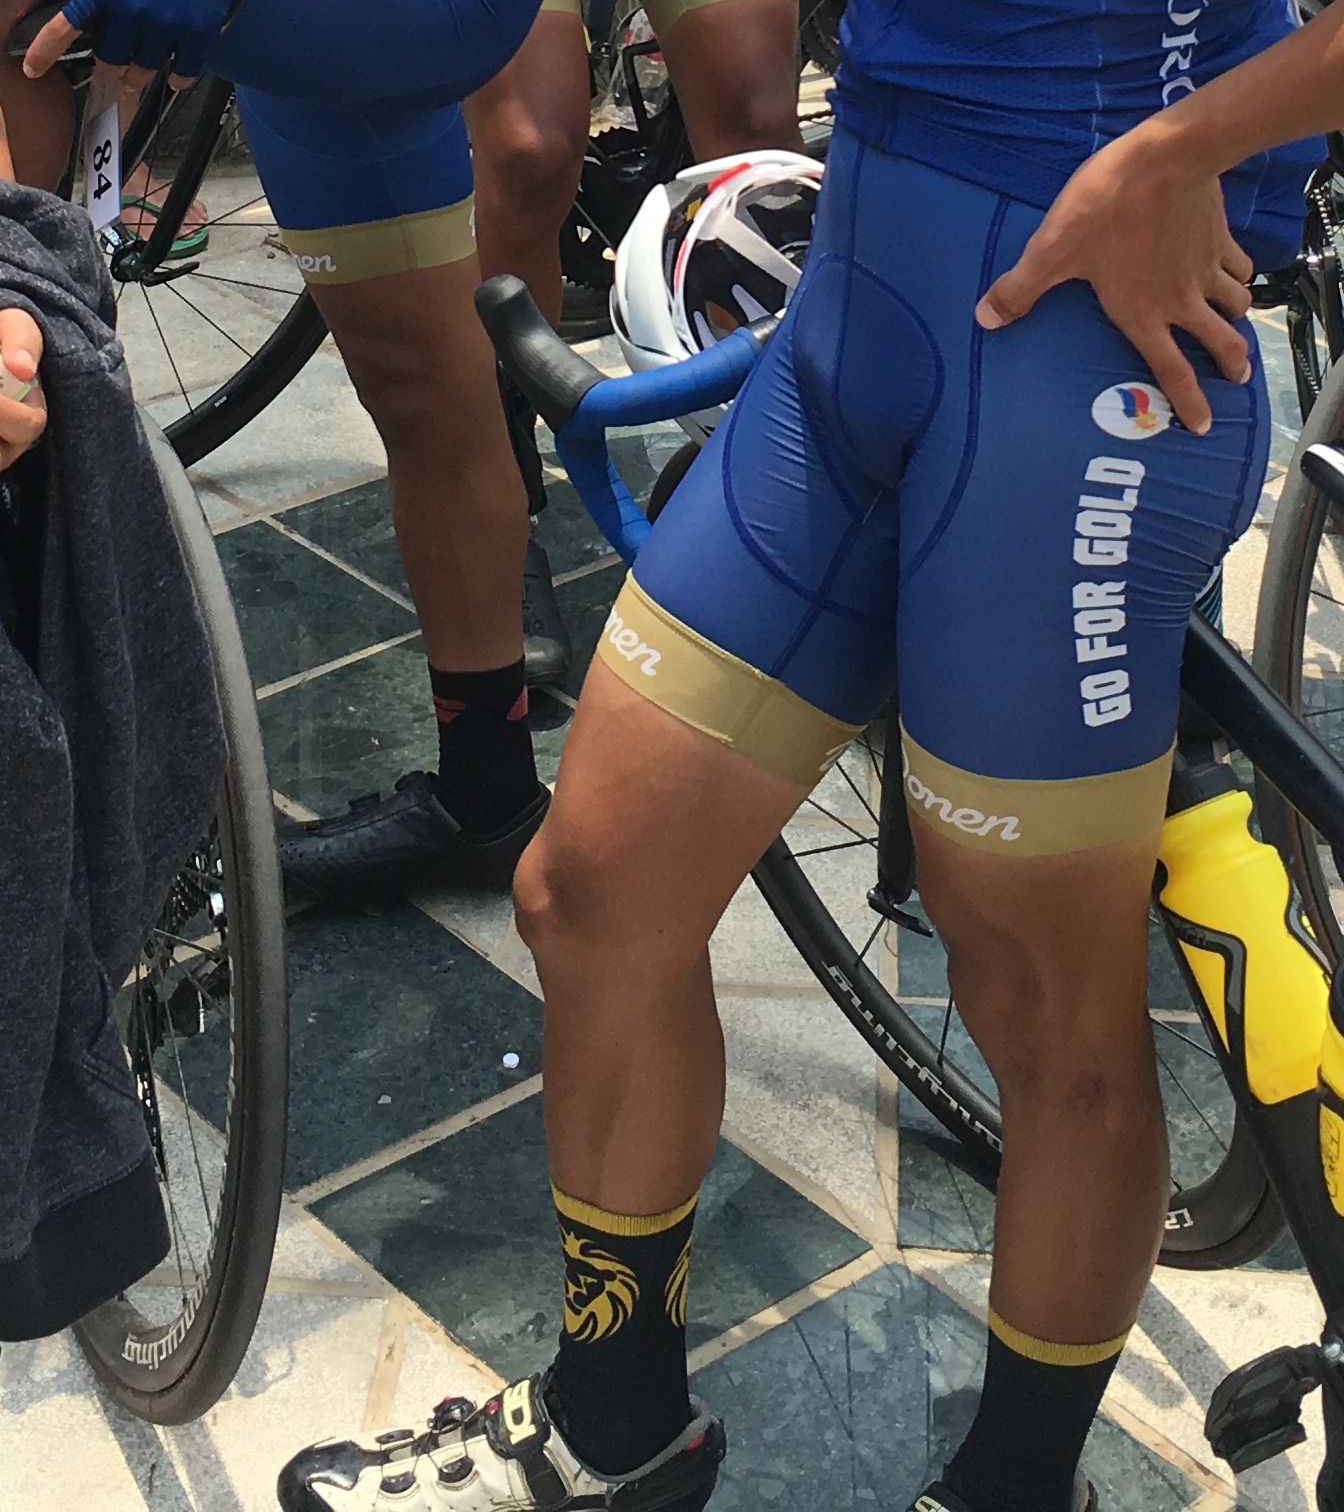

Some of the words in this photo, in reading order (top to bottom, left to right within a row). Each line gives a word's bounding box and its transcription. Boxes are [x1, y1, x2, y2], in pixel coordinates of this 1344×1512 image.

[90, 138, 115, 202] 84
[1072, 455, 1146, 566] GOLD
[604, 610, 661, 677] nen
[1072, 581, 1129, 664] FOR
[1081, 670, 1133, 728] GO
